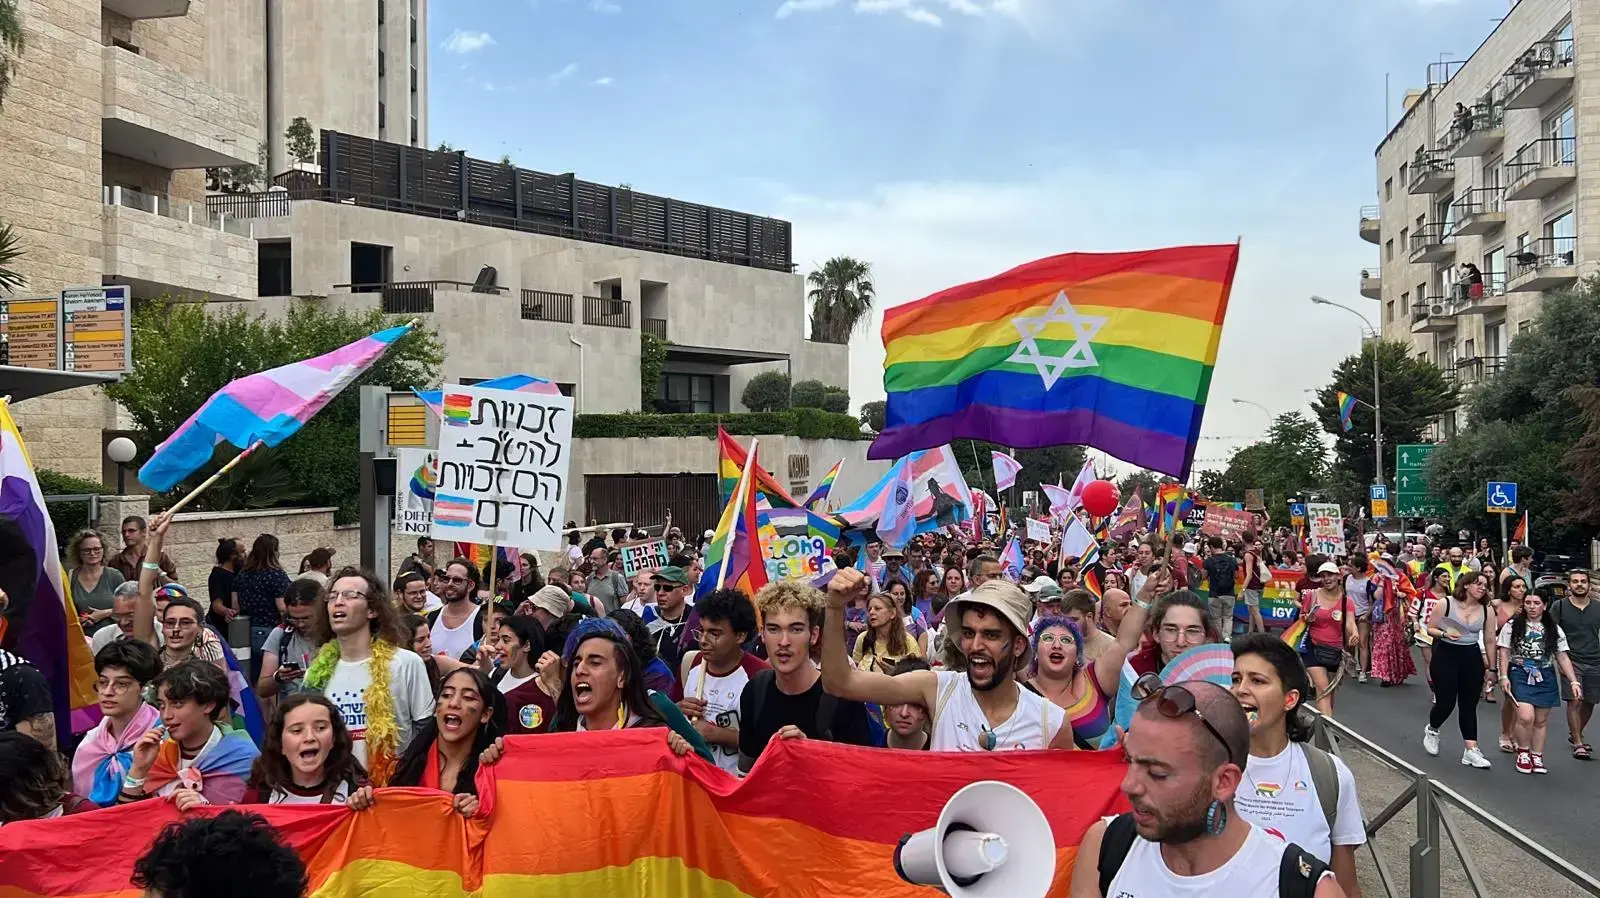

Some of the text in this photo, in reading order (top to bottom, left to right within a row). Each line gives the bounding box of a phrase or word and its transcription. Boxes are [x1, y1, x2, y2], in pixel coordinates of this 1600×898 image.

[470, 398, 566, 434] זכויות
[512, 469, 562, 502] הם
[475, 499, 556, 534] אדם
[760, 538, 825, 557] trong
[625, 554, 669, 573] מהפכה
[1272, 606, 1294, 619] IGY
[336, 703, 365, 714] שרא
